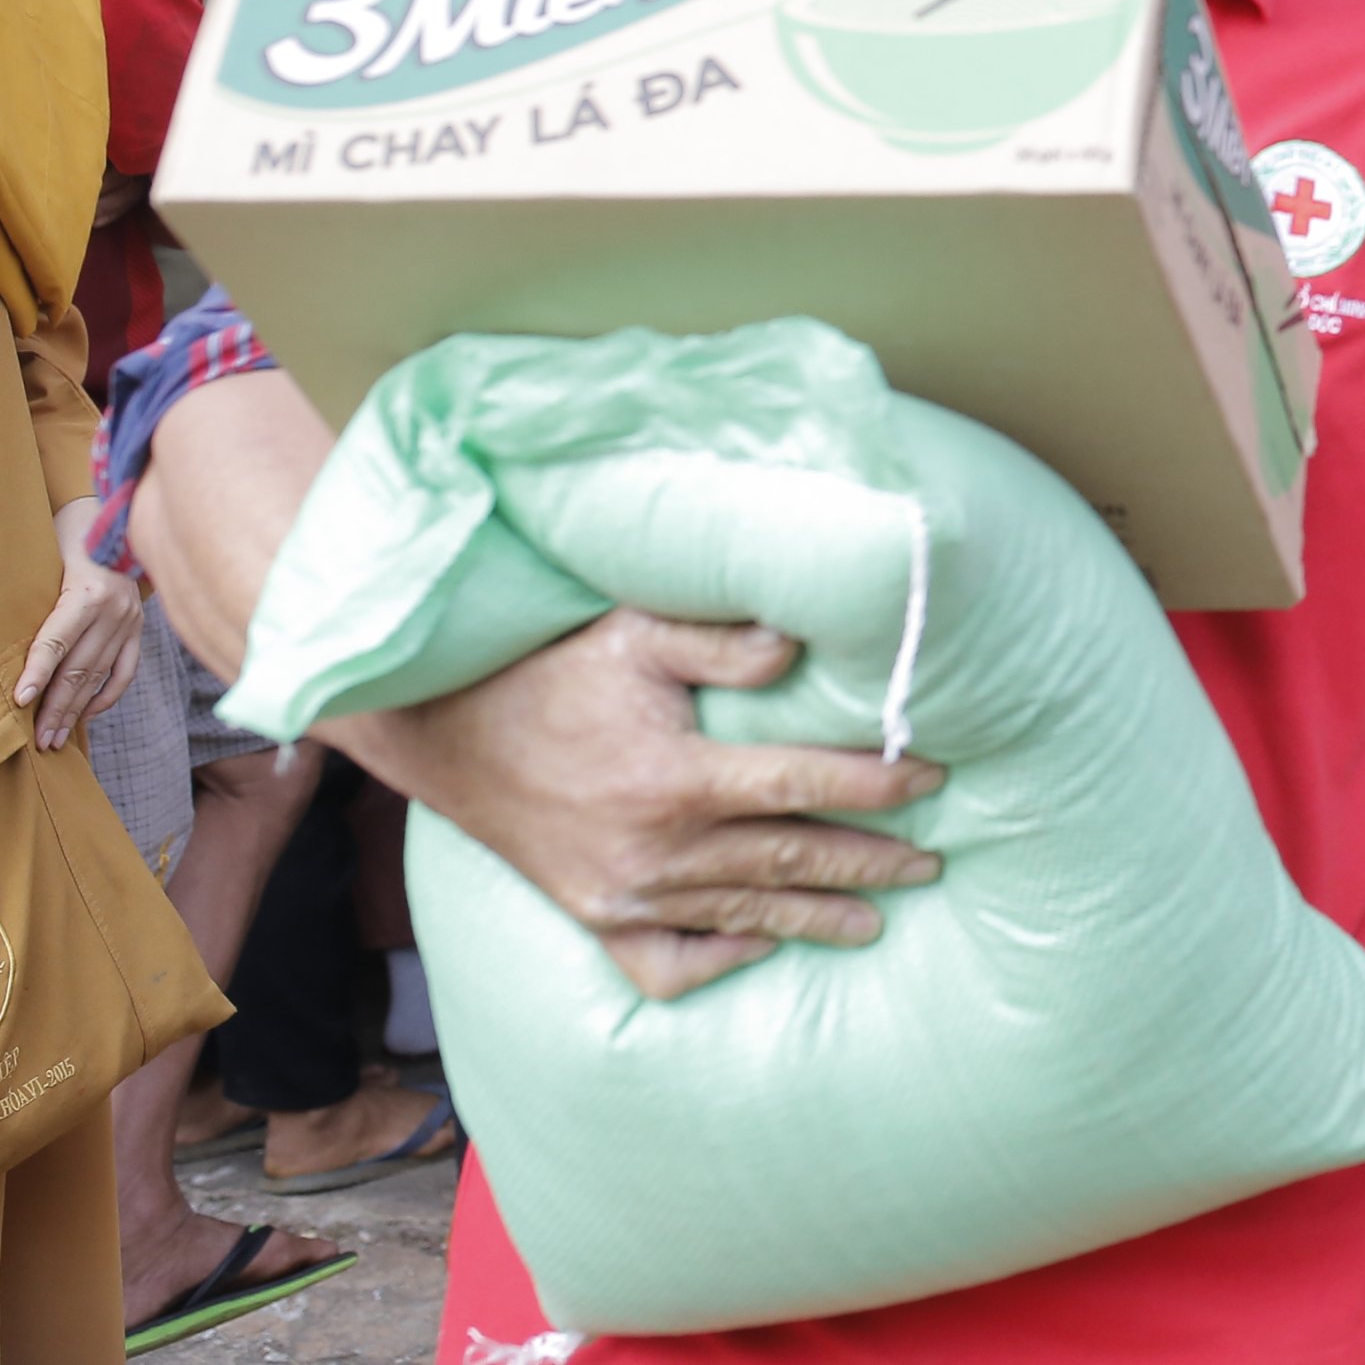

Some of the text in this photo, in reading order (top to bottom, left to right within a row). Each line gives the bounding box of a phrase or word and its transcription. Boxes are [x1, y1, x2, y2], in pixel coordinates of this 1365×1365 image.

[250, 55, 741, 176] MÌ CHAY LÁ ĐA
